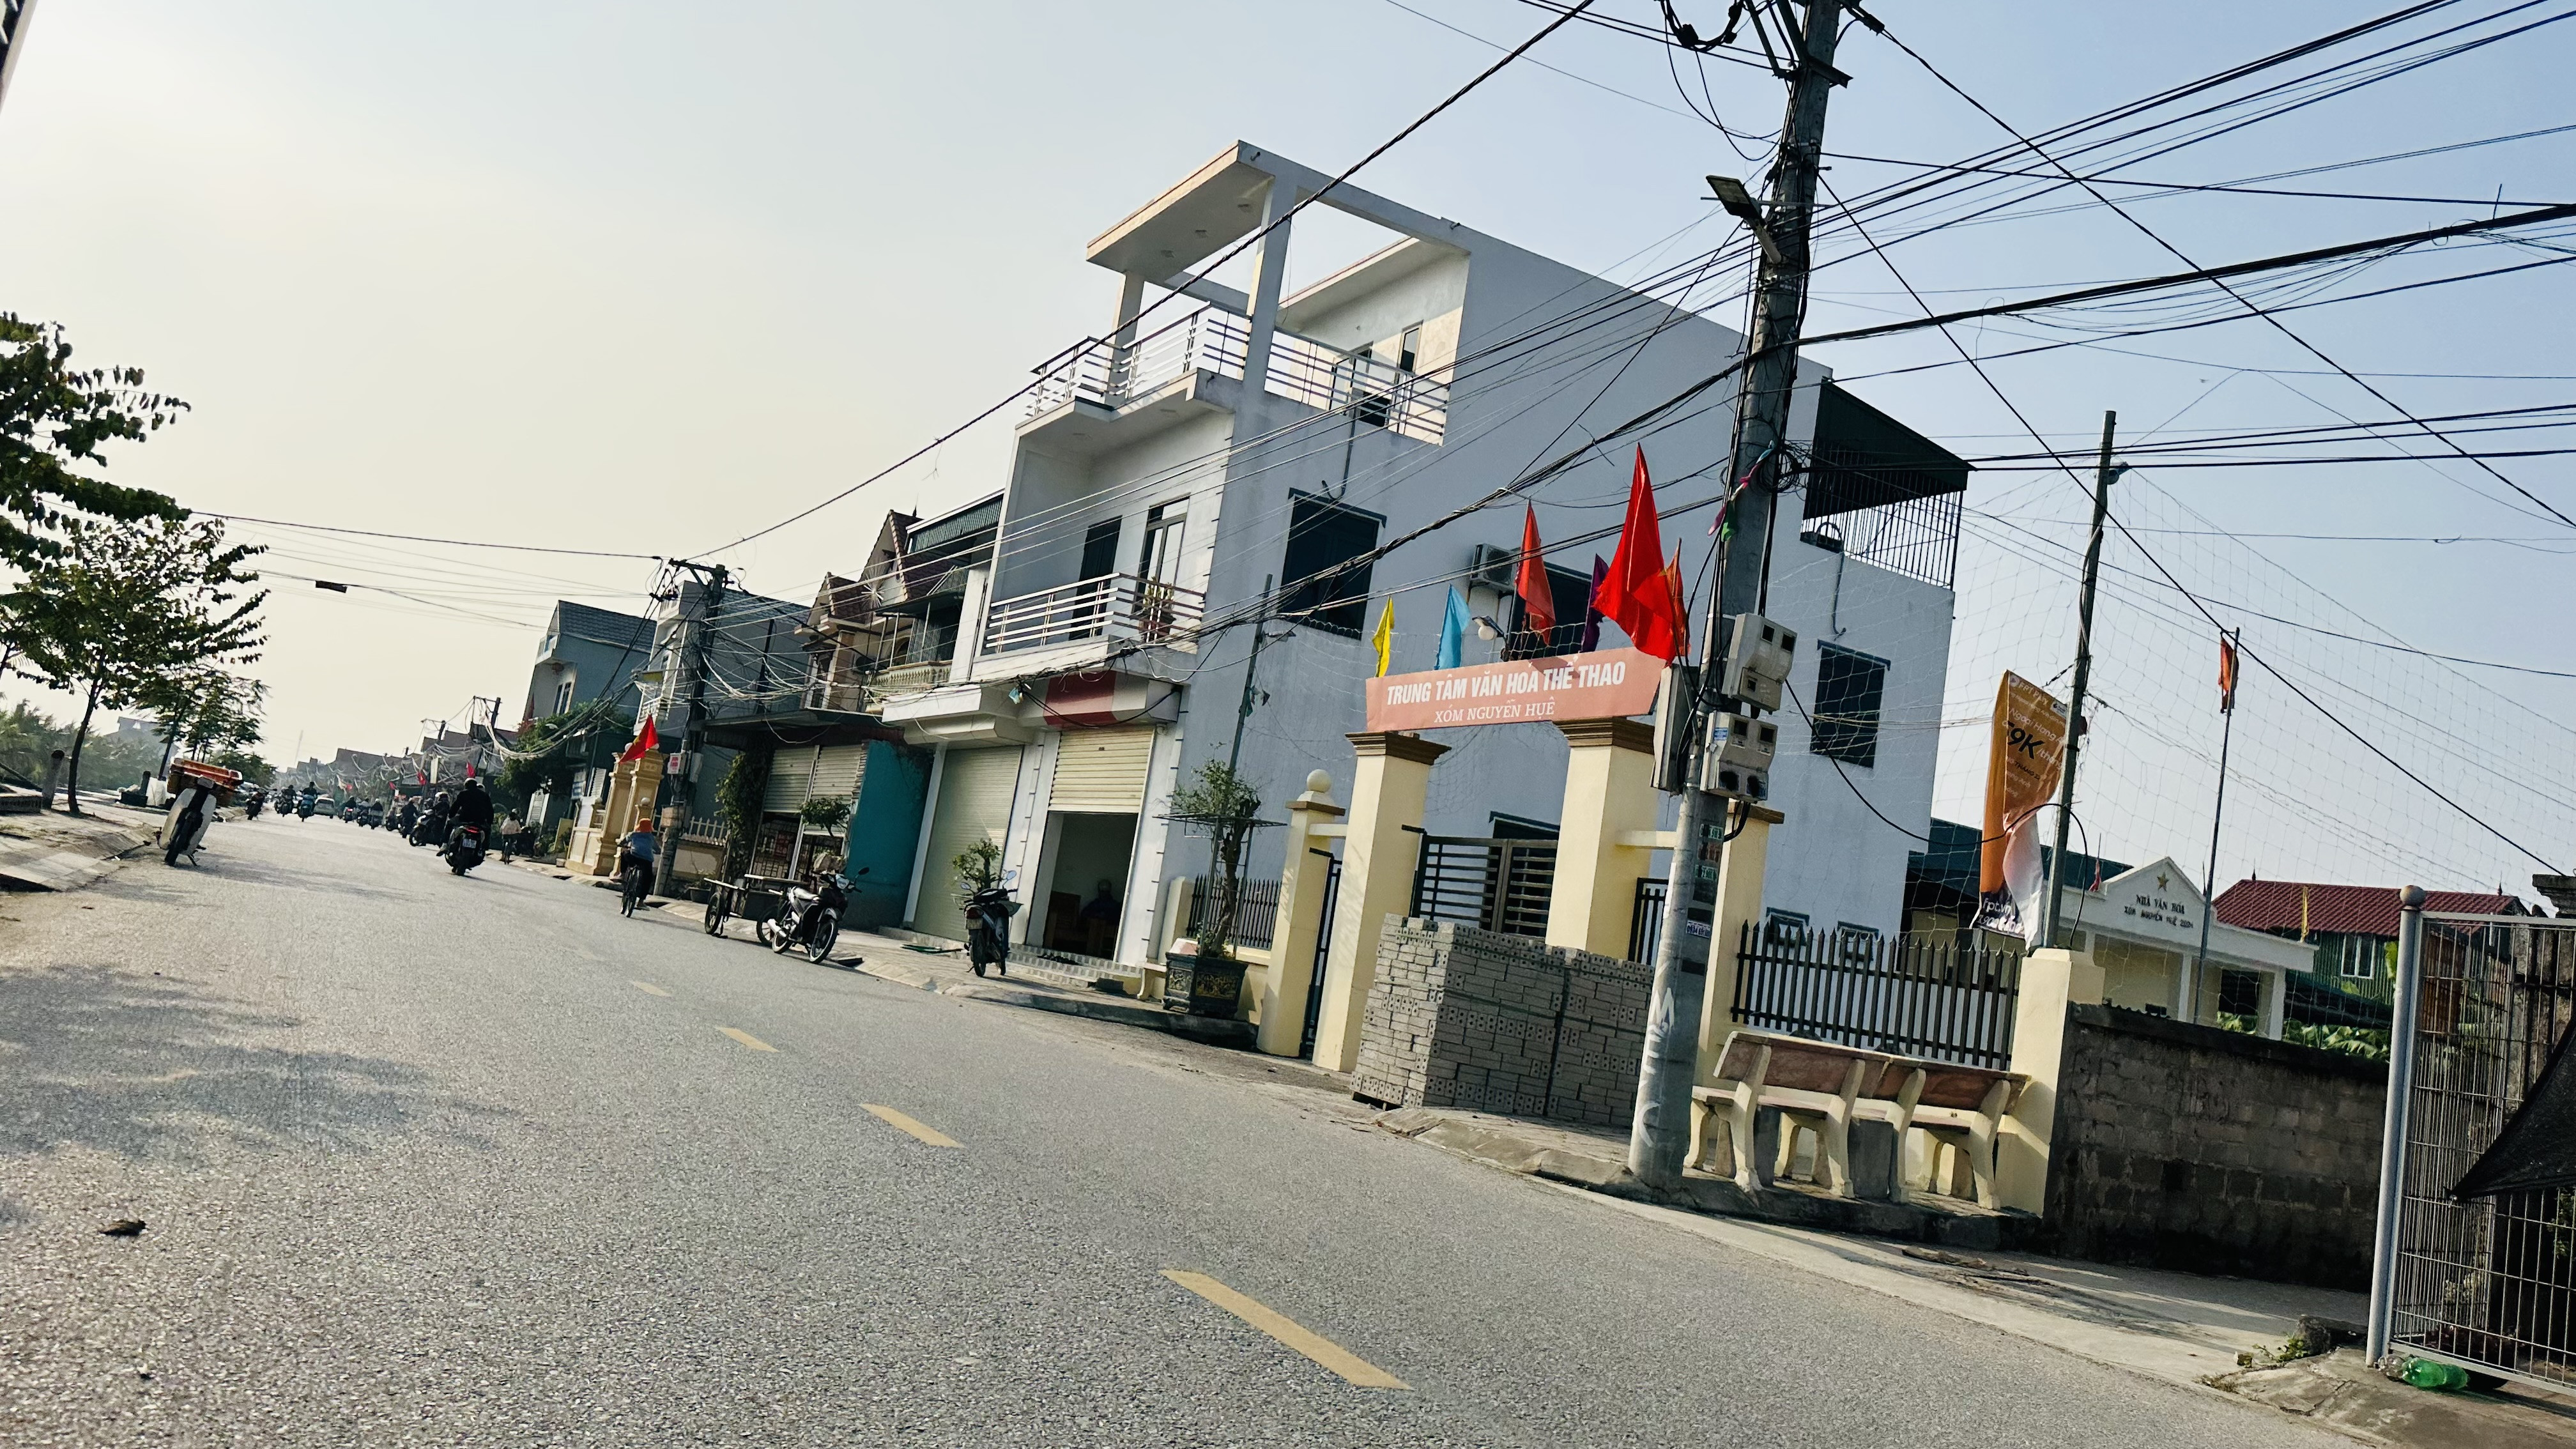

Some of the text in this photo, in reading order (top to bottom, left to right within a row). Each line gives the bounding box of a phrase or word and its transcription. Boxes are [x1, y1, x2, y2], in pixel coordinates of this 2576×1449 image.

[1387, 682, 1432, 705] TRUNG
[1436, 673, 1468, 701] TÂM
[1471, 671, 1503, 698] VĂN
[1543, 655, 1579, 691] THỂ
[1578, 661, 1626, 688] THAO
[1434, 704, 1464, 723] XÓM
[1467, 698, 1522, 720] NGUYỄN
